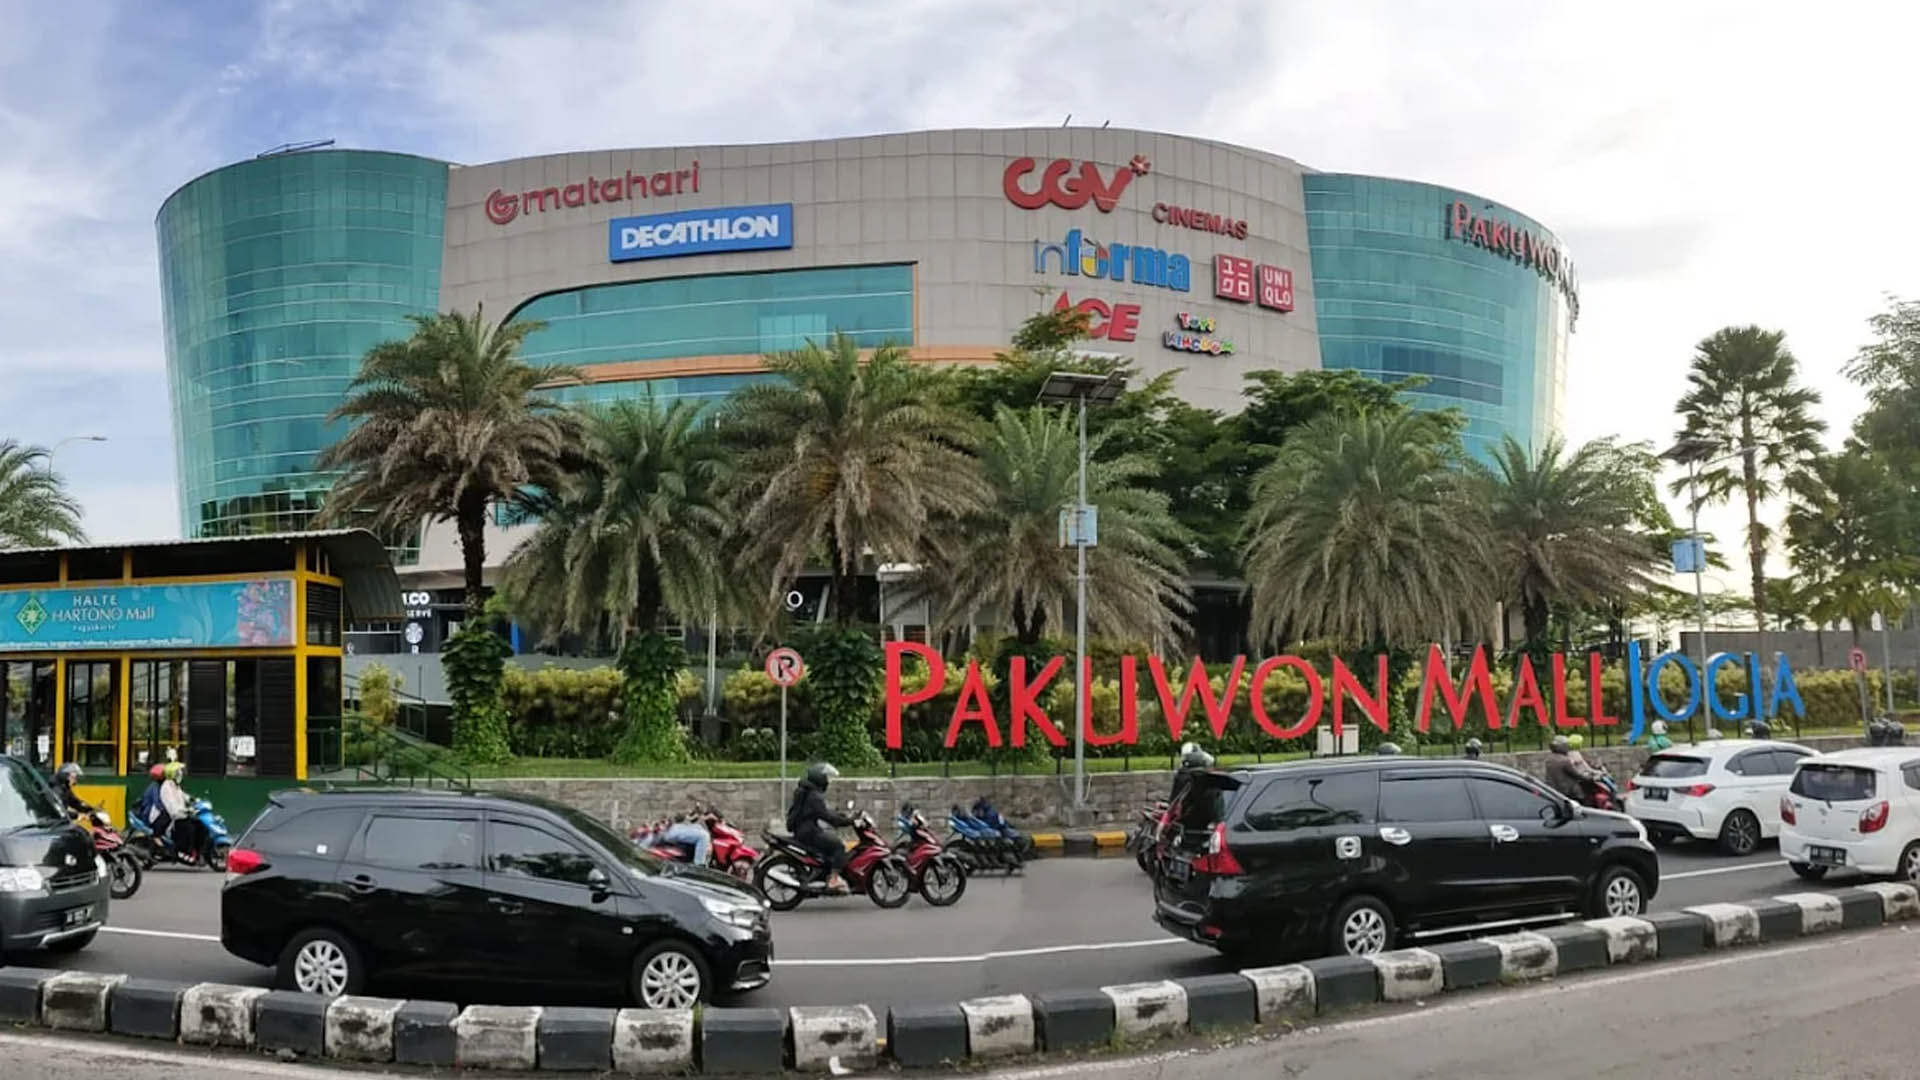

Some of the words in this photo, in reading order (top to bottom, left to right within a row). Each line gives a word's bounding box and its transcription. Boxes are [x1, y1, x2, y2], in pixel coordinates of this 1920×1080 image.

[522, 160, 699, 215] matahari
[1003, 156, 1134, 213] CGV
[620, 213, 779, 250] DECATHLON
[1152, 203, 1248, 240] CINEMAS
[1034, 228, 1191, 292] informa
[1445, 198, 1568, 296] PAKUWON
[1264, 267, 1289, 289] UNI
[1264, 285, 1291, 305] QLO
[52, 607, 123, 622] HARTONO
[126, 605, 155, 620] Mall
[73, 594, 118, 607] HALTE
[885, 641, 1388, 748] PAKUWON
[1416, 643, 1619, 732] MALL
